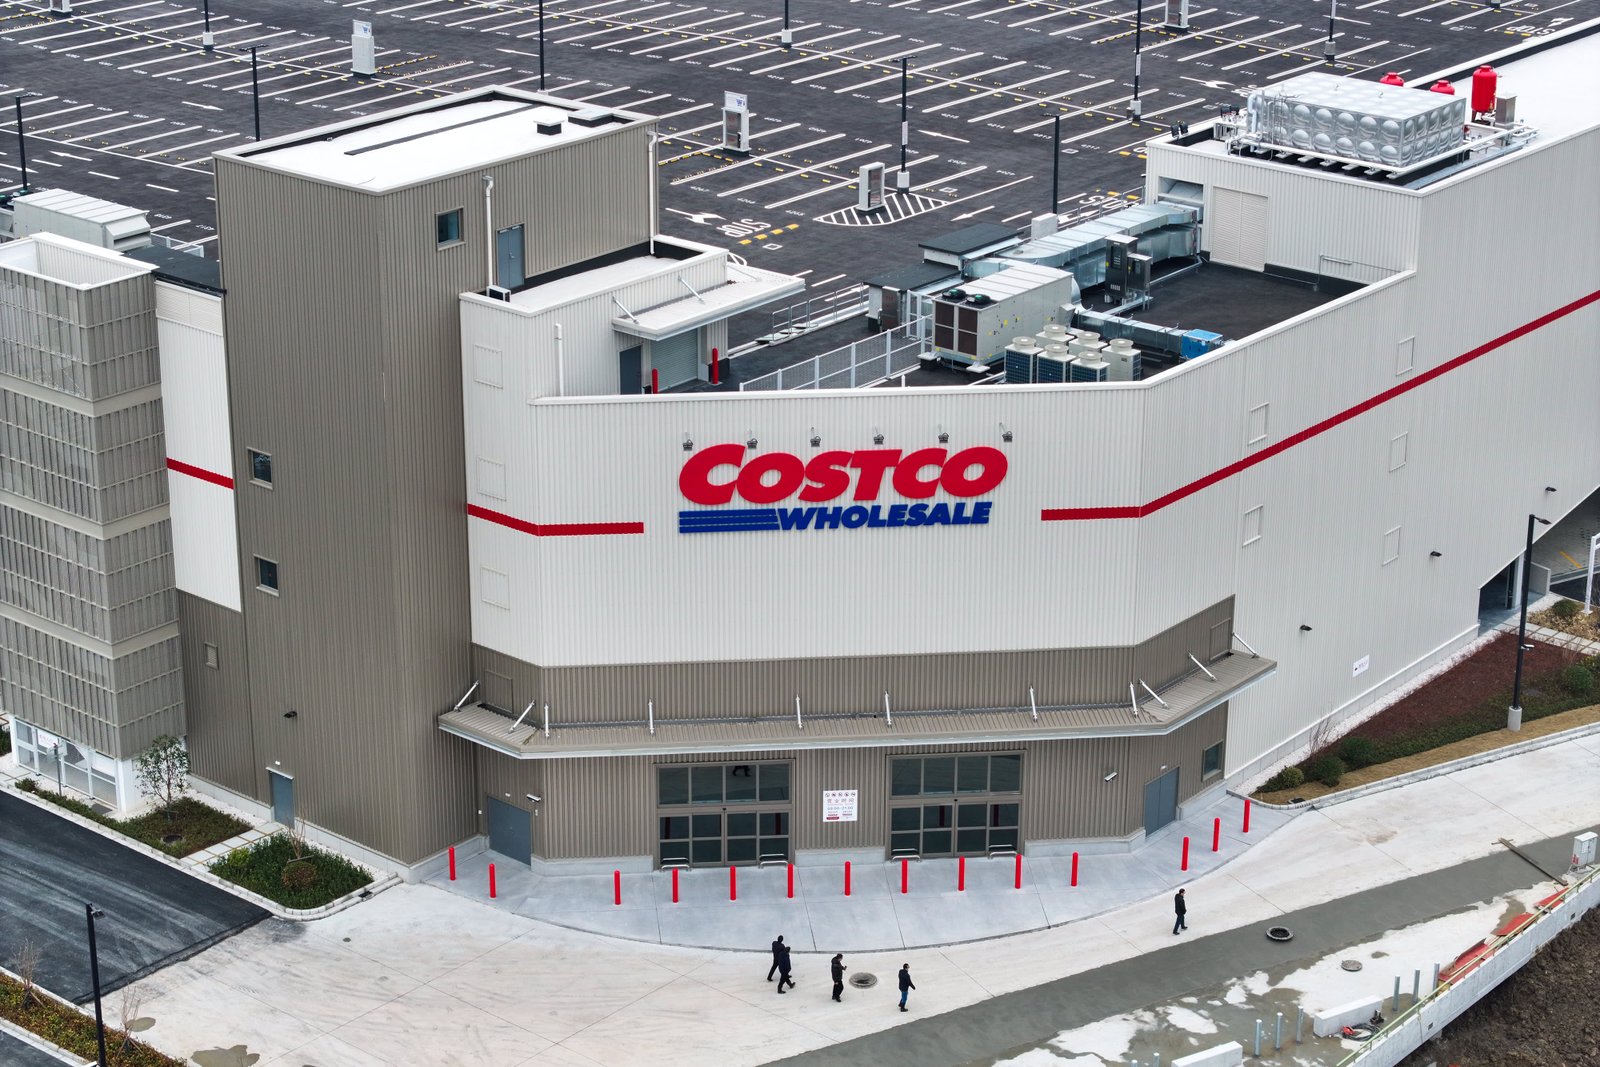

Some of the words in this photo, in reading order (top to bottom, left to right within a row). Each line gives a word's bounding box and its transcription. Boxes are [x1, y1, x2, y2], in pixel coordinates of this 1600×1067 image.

[716, 218, 772, 238] STOP
[679, 444, 1008, 505] COSTCO
[776, 502, 992, 531] WHOLESALE
